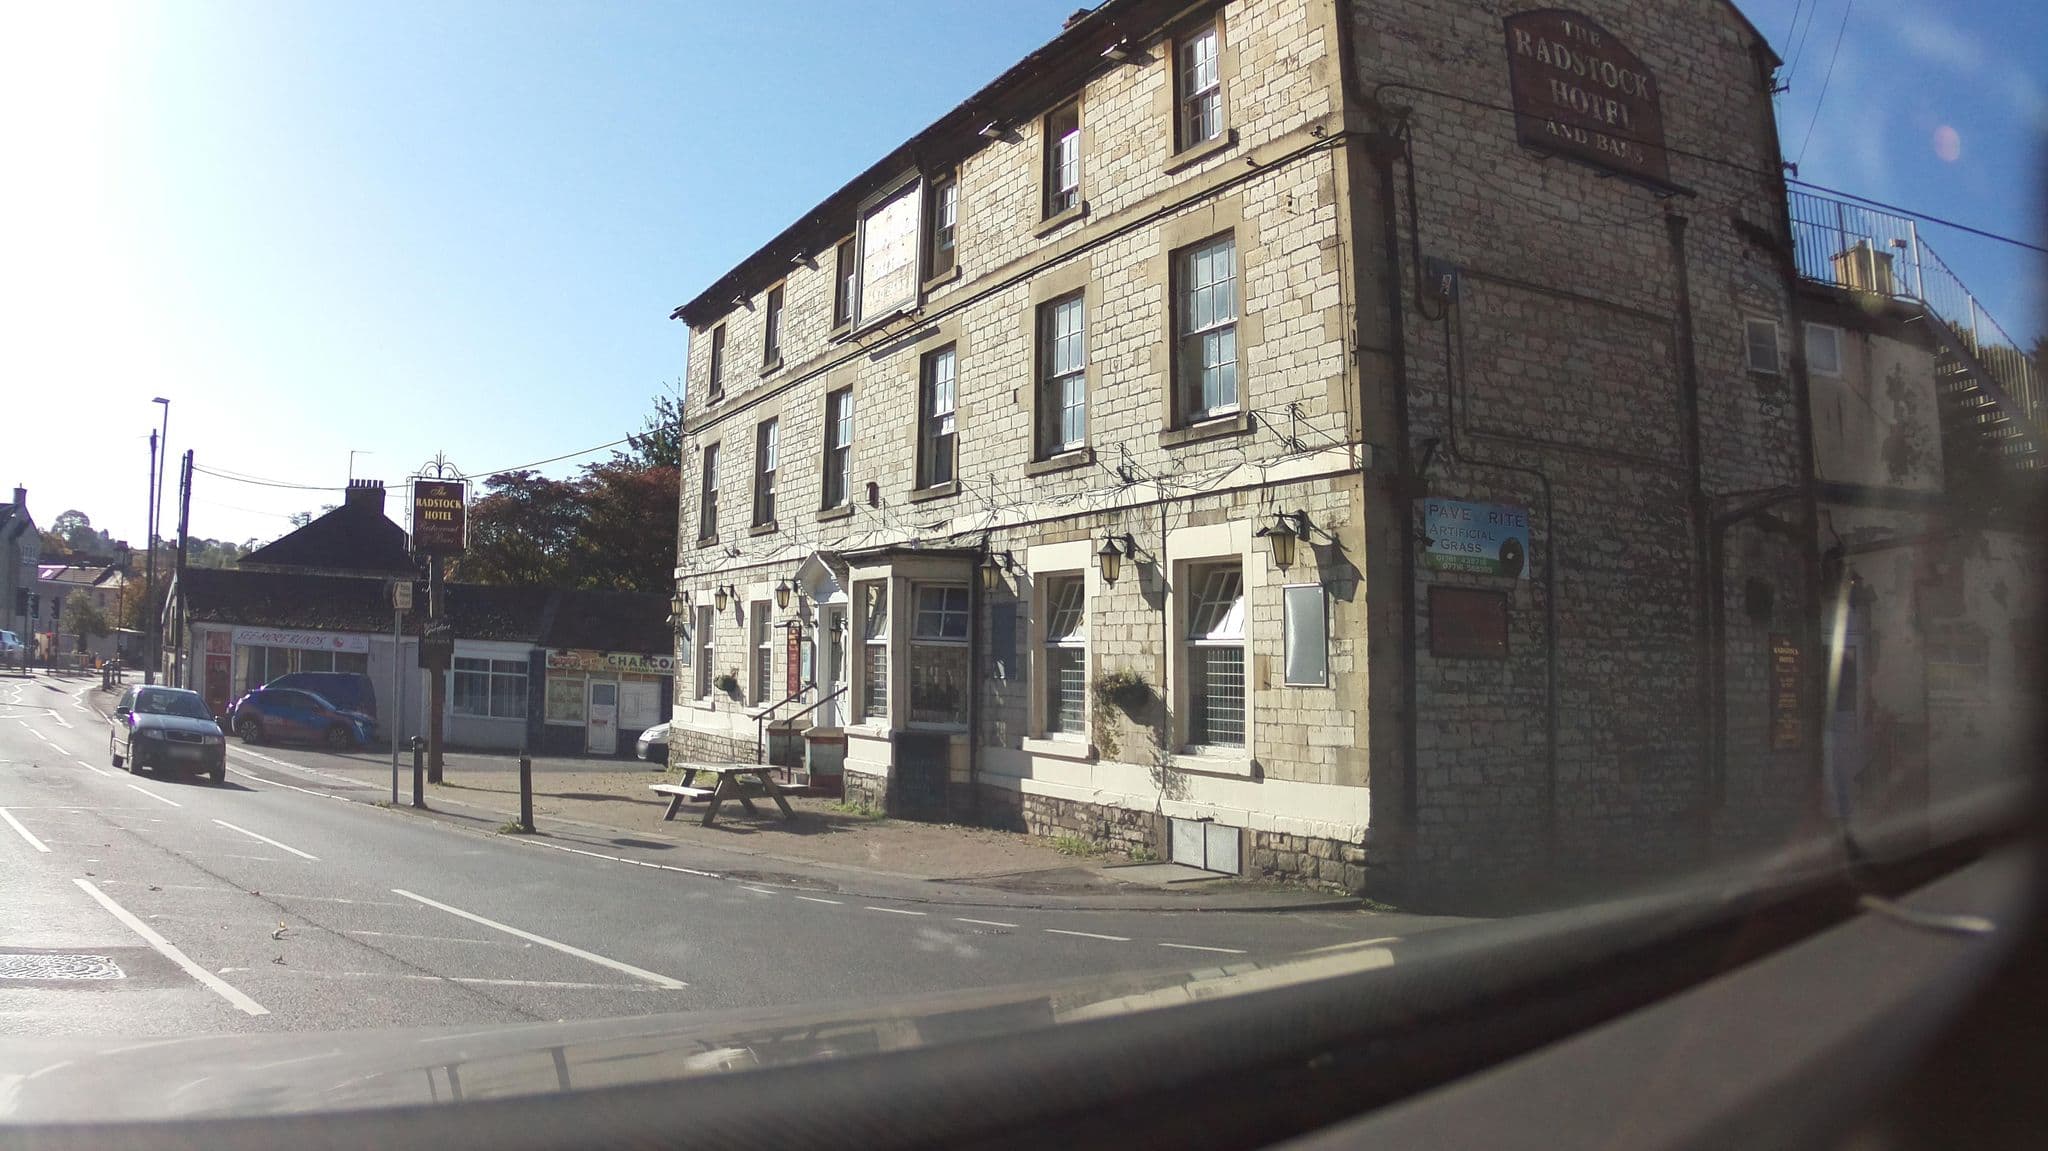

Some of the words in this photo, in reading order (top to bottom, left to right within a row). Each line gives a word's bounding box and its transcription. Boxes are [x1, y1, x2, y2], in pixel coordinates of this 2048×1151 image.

[1514, 28, 1648, 99] RADSTOCK
[1546, 120, 1588, 144] AND
[416, 498, 462, 509] RADSTOCK
[425, 511, 452, 520] HOTEL
[1429, 504, 1472, 521] PAVE
[1489, 511, 1525, 528] RITE
[1429, 523, 1496, 541] ARTIFICIAL
[1440, 538, 1482, 553] GRASS
[608, 655, 674, 670] CHARCO
